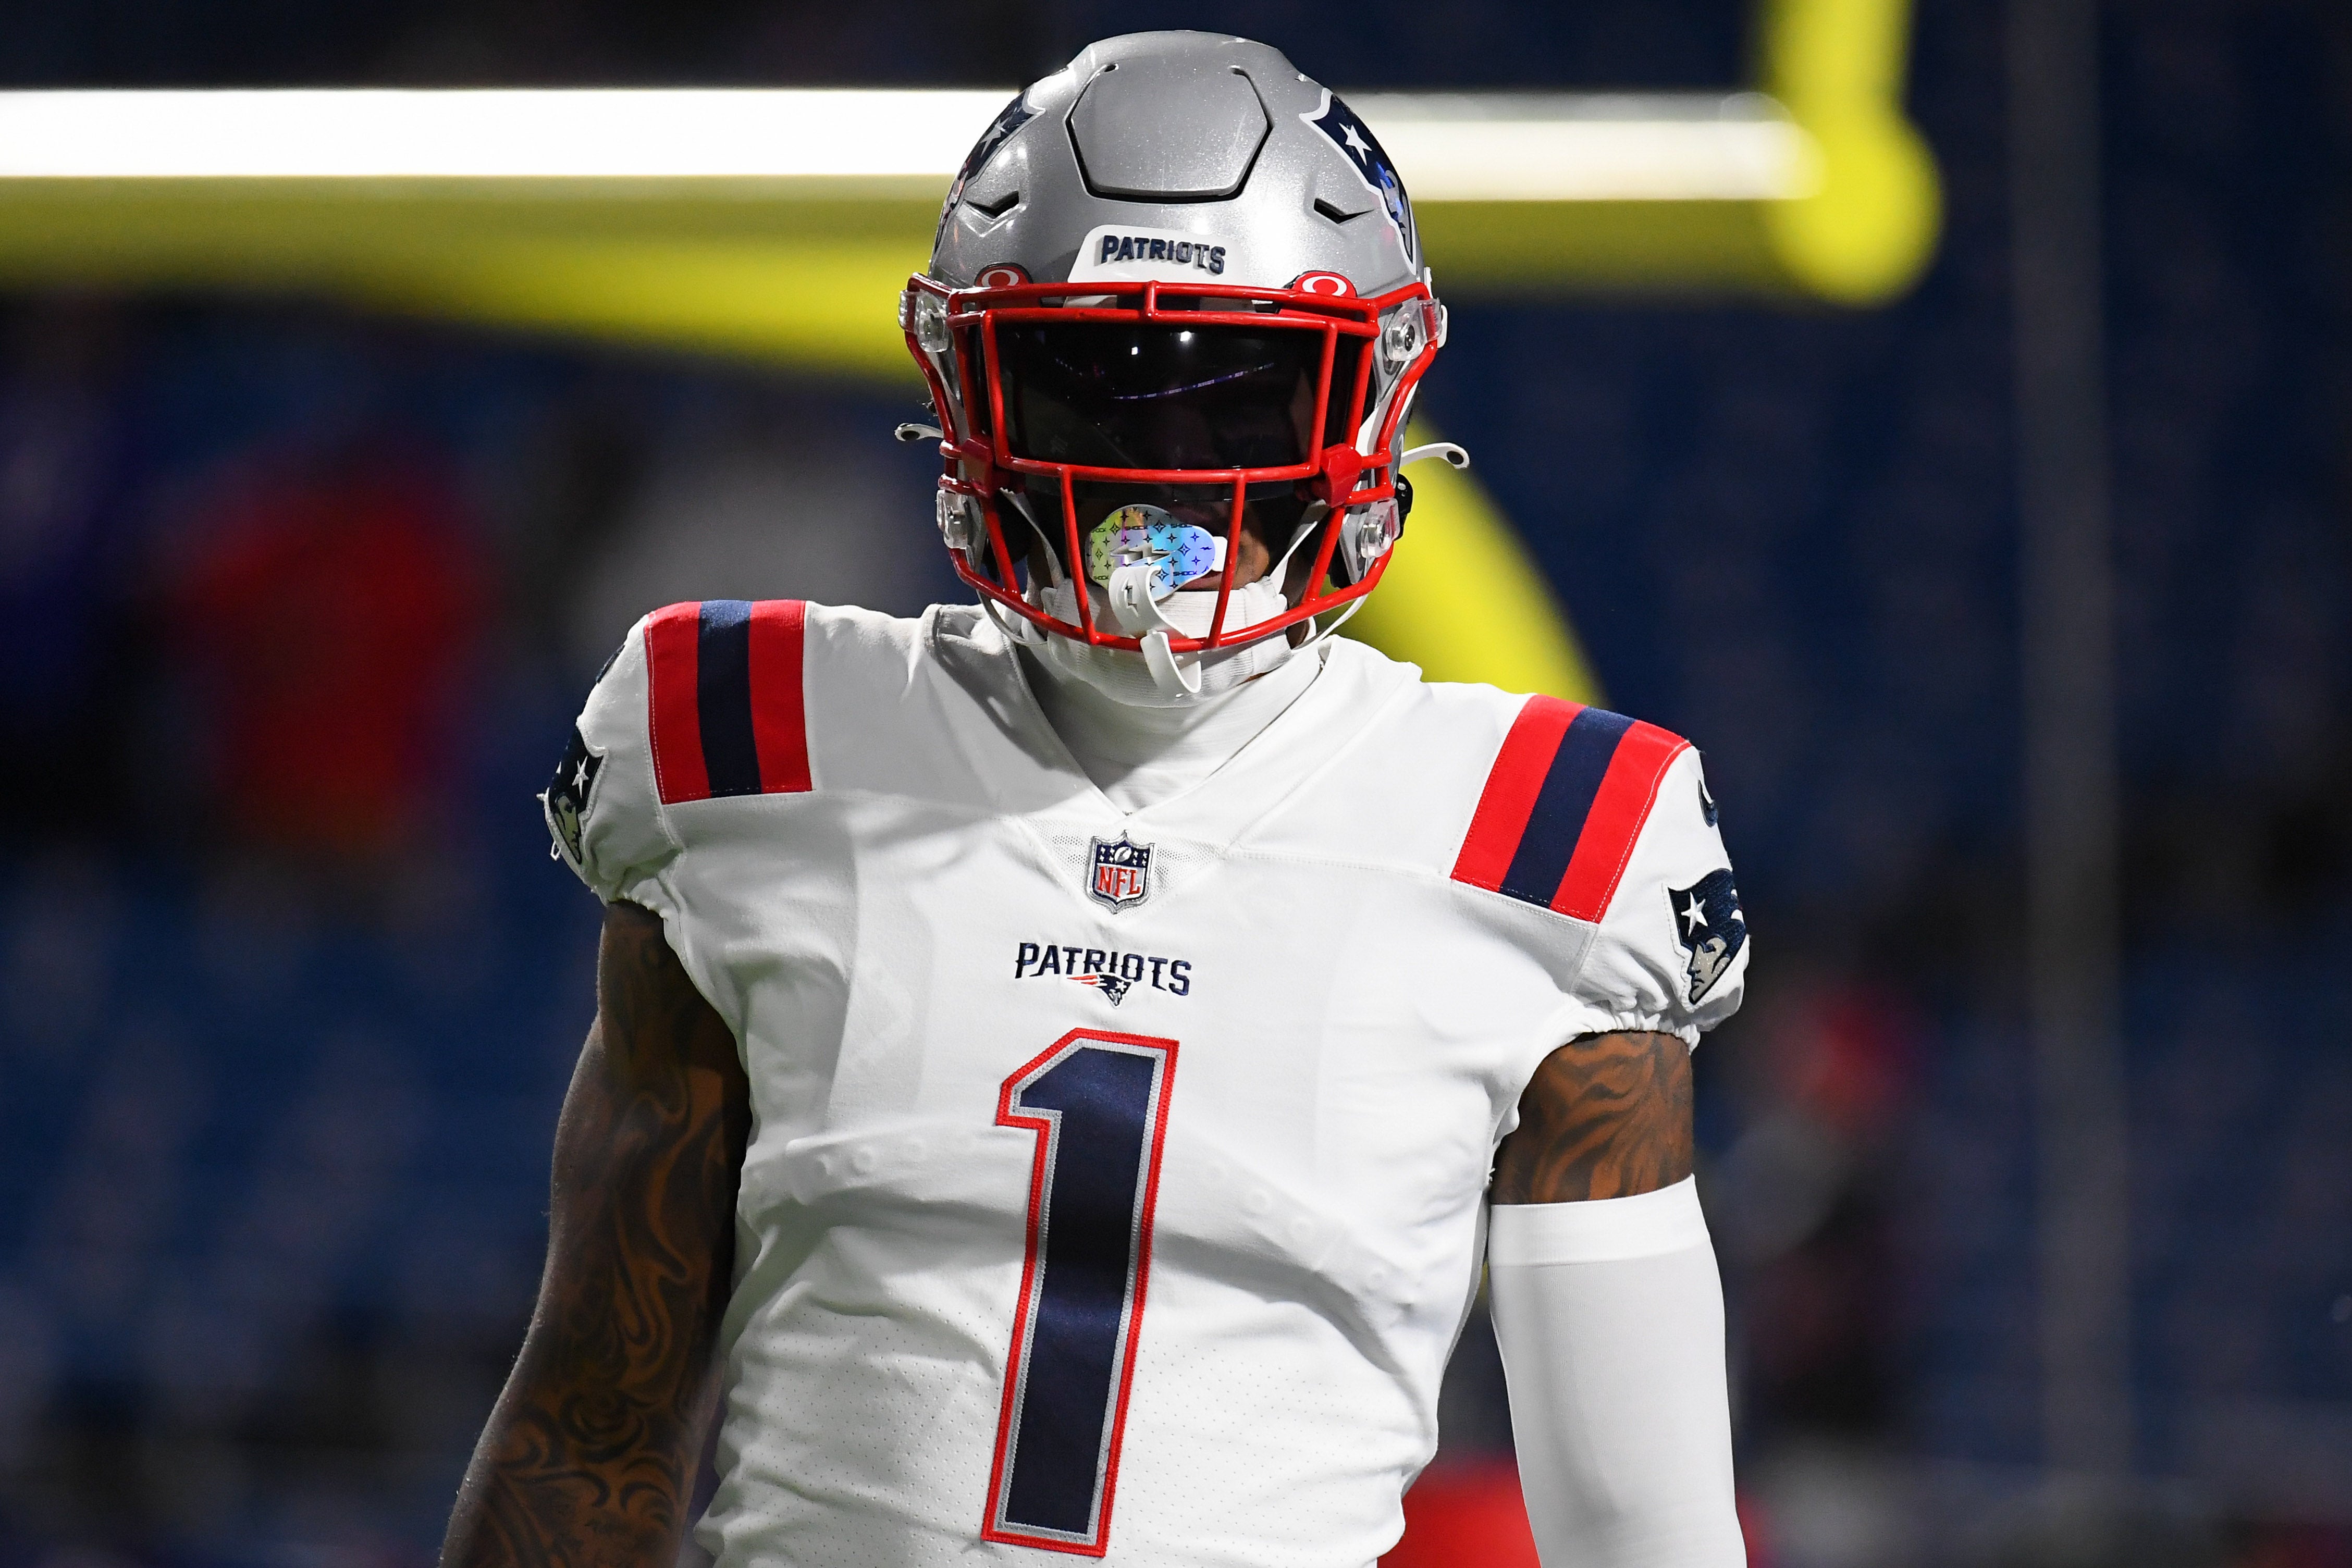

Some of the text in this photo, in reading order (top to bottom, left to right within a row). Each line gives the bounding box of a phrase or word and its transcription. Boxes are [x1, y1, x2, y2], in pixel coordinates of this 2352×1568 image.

[1100, 235, 1226, 275] PATRIOTS
[1097, 866, 1141, 897] NFL
[1014, 942, 1192, 996] PATRIOTS
[980, 1028, 1180, 1557] 1
